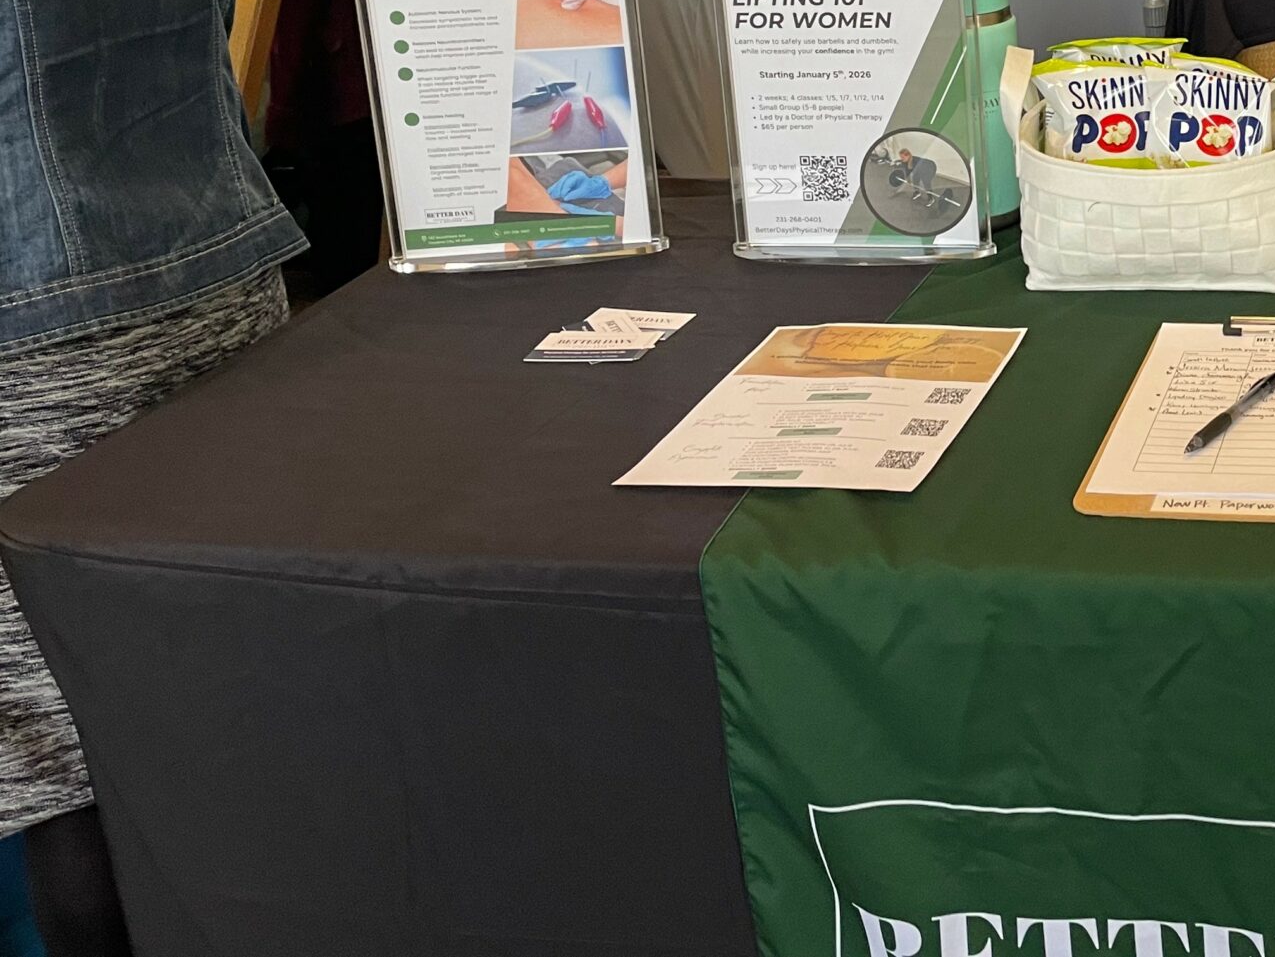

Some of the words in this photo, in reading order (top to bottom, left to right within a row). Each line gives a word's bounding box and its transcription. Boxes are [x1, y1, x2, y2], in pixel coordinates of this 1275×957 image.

[735, 12, 784, 28] FOR
[793, 12, 892, 28] WOMEN
[759, 71, 794, 79] Starting
[796, 71, 830, 79] January
[848, 70, 871, 78] 2026
[774, 114, 783, 122] by
[854, 113, 882, 121] Therapy
[1169, 112, 1263, 156] POP
[752, 163, 767, 171] Sign
[426, 211, 452, 219] BETTER
